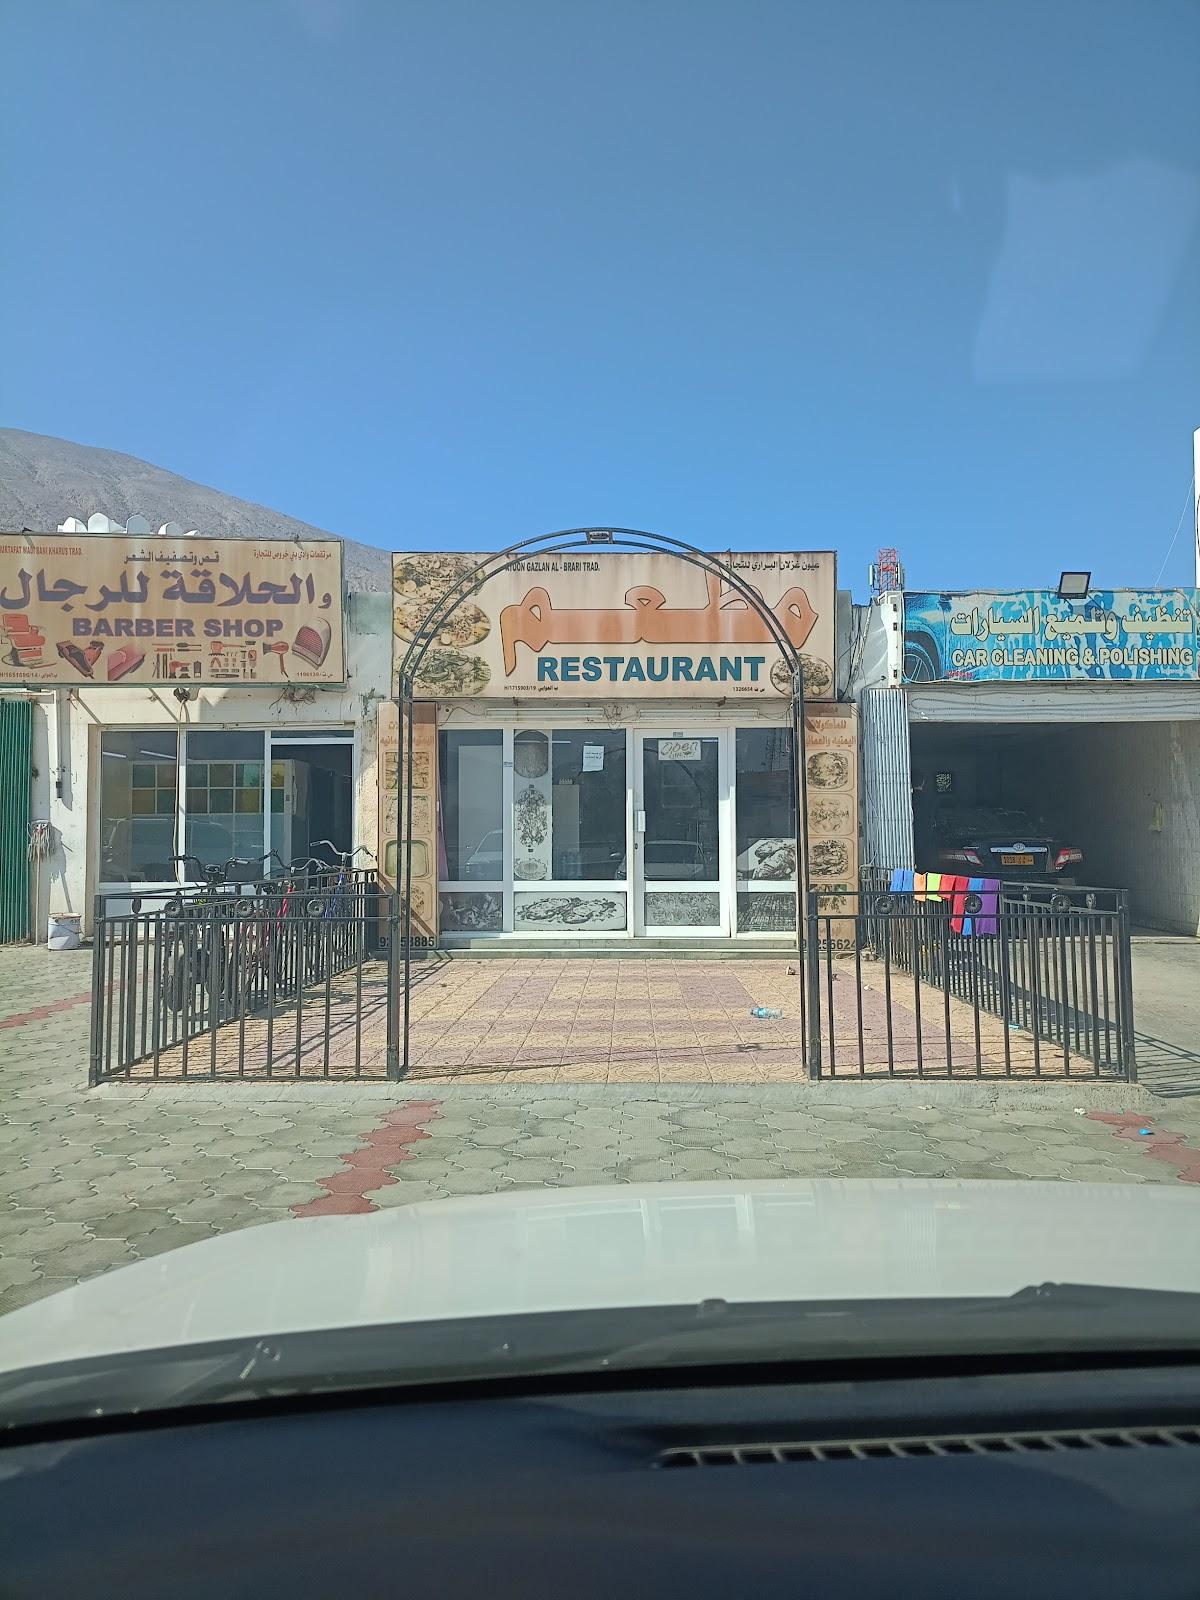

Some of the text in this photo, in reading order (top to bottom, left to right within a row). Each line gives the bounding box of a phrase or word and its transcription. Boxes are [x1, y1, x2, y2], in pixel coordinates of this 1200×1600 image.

[527, 562, 549, 571] GAZLAN
[551, 562, 559, 571] AL
[564, 562, 581, 571] BRARI
[583, 562, 600, 571] TRAD.
[780, 560, 800, 570] غزلان
[802, 560, 820, 571] عيون
[0, 567, 150, 612] للرجال
[72, 617, 283, 637] BARBER SHOP
[500, 561, 819, 677] مطعم
[950, 604, 1192, 641] تنظيف وتلميع السيارات
[951, 648, 1193, 667] CAR CLEANING & POLISHING
[537, 656, 765, 682] RESTAURANT
